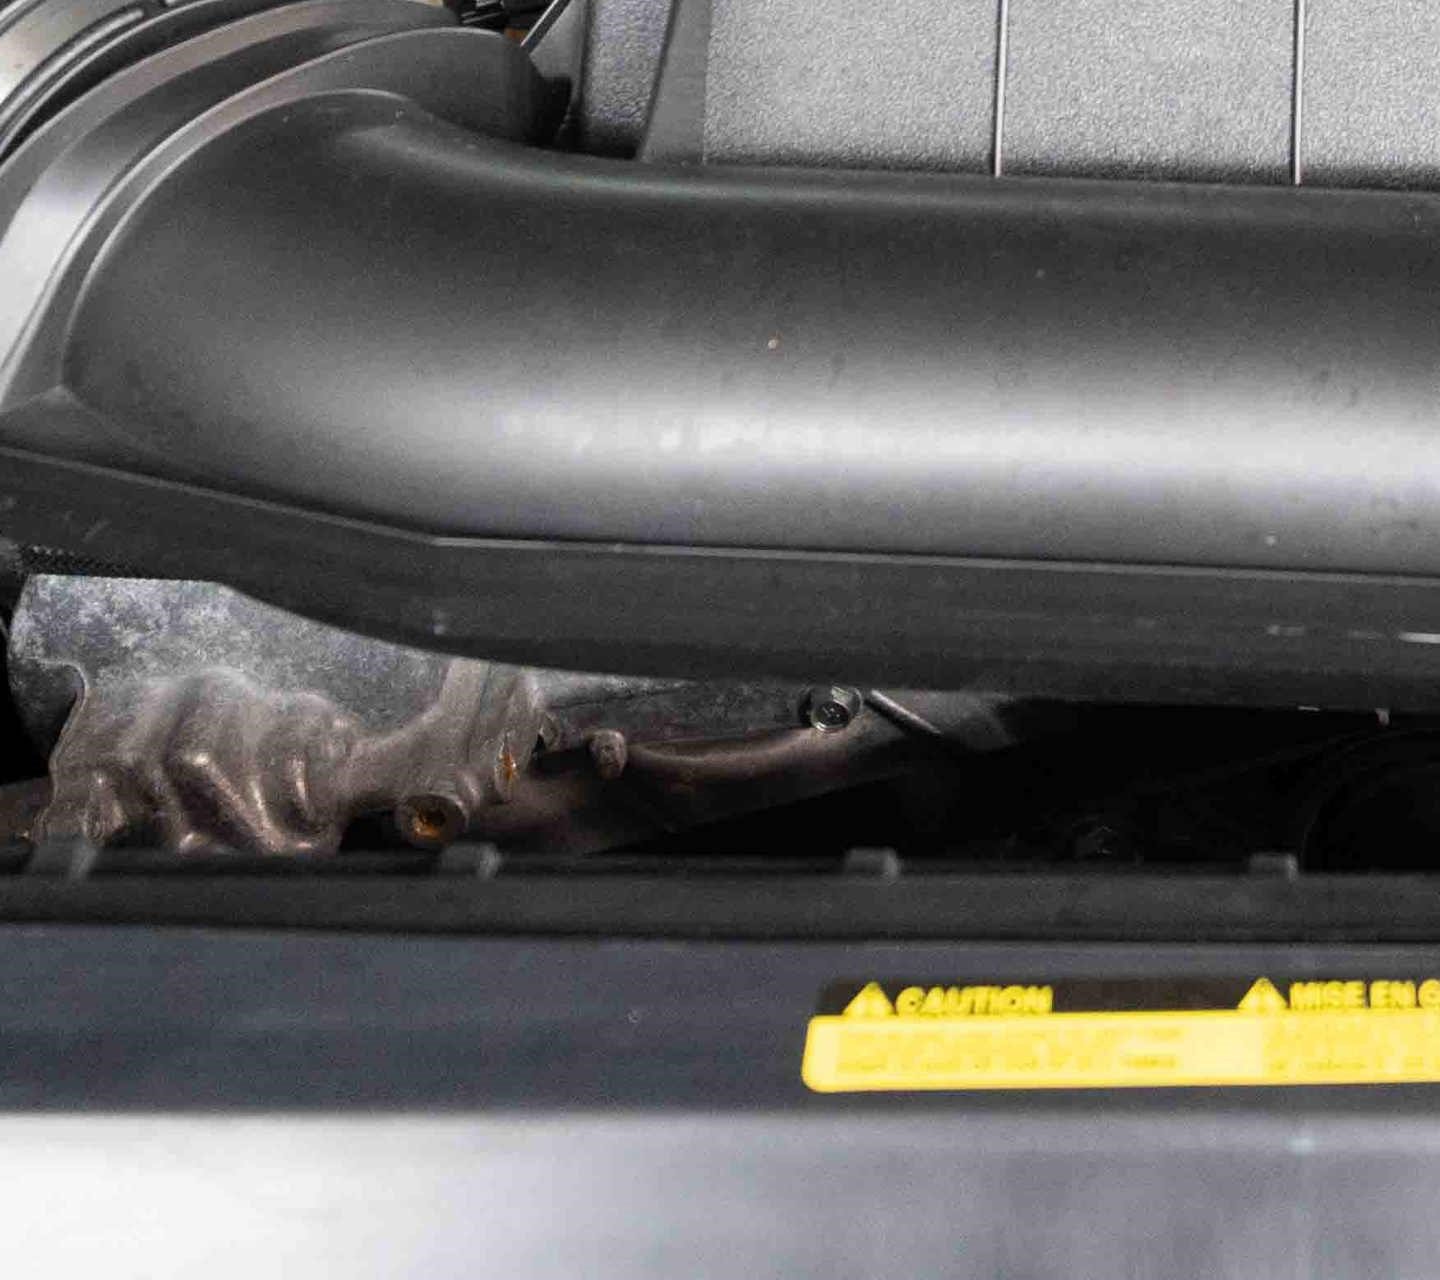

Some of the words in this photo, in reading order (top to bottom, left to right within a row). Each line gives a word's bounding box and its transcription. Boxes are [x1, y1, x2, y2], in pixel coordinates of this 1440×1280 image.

[895, 984, 1054, 1015] CAUTION
[1289, 980, 1365, 1009] MISE
[1369, 979, 1417, 1009] EN
